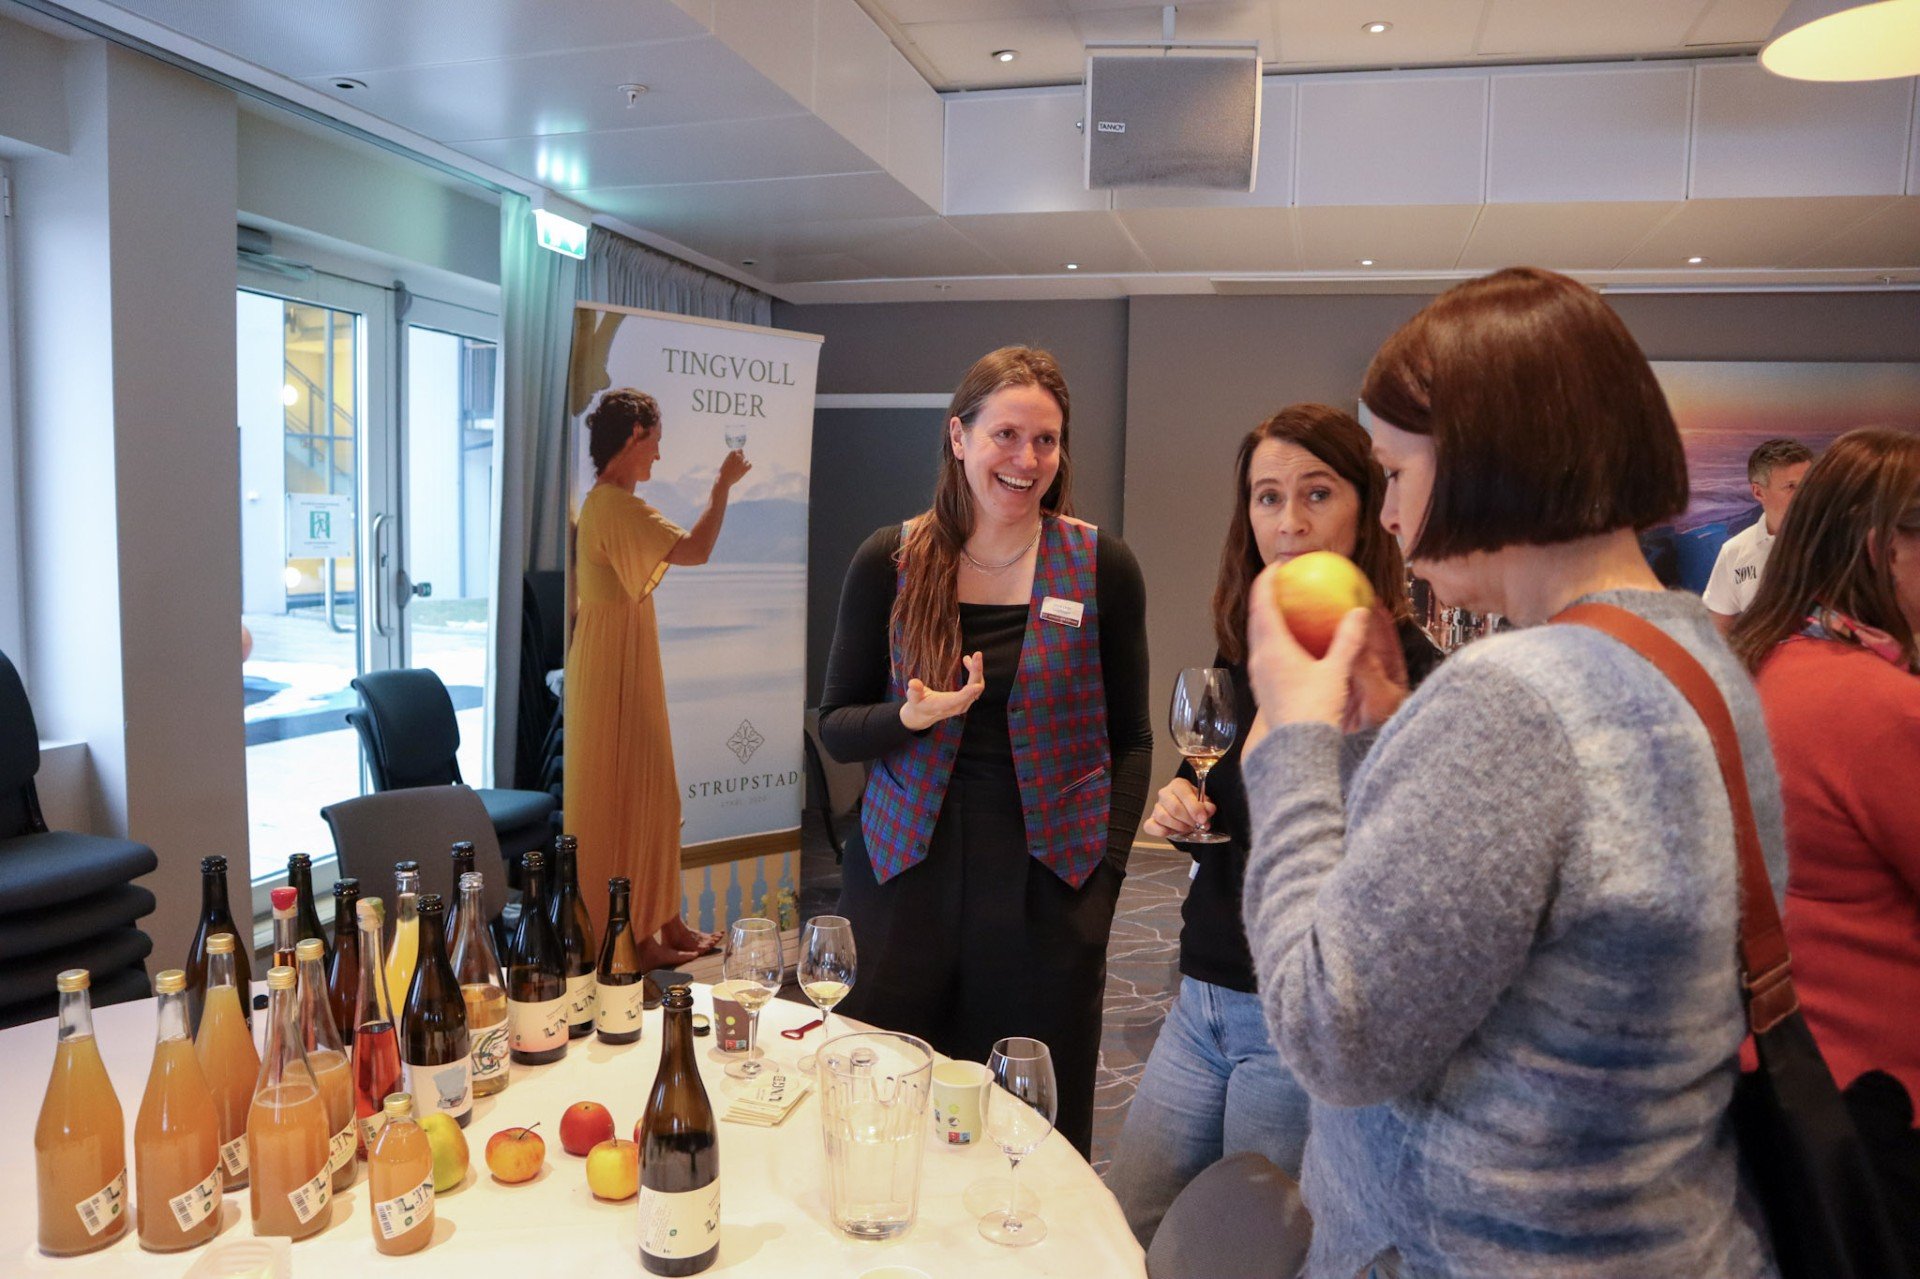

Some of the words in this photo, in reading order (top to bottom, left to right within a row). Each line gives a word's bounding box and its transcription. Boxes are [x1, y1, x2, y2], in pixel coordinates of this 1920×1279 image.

[662, 348, 796, 386] TINGVOLL
[691, 388, 766, 418] SIDER
[688, 770, 798, 799] STRUPSTAD
